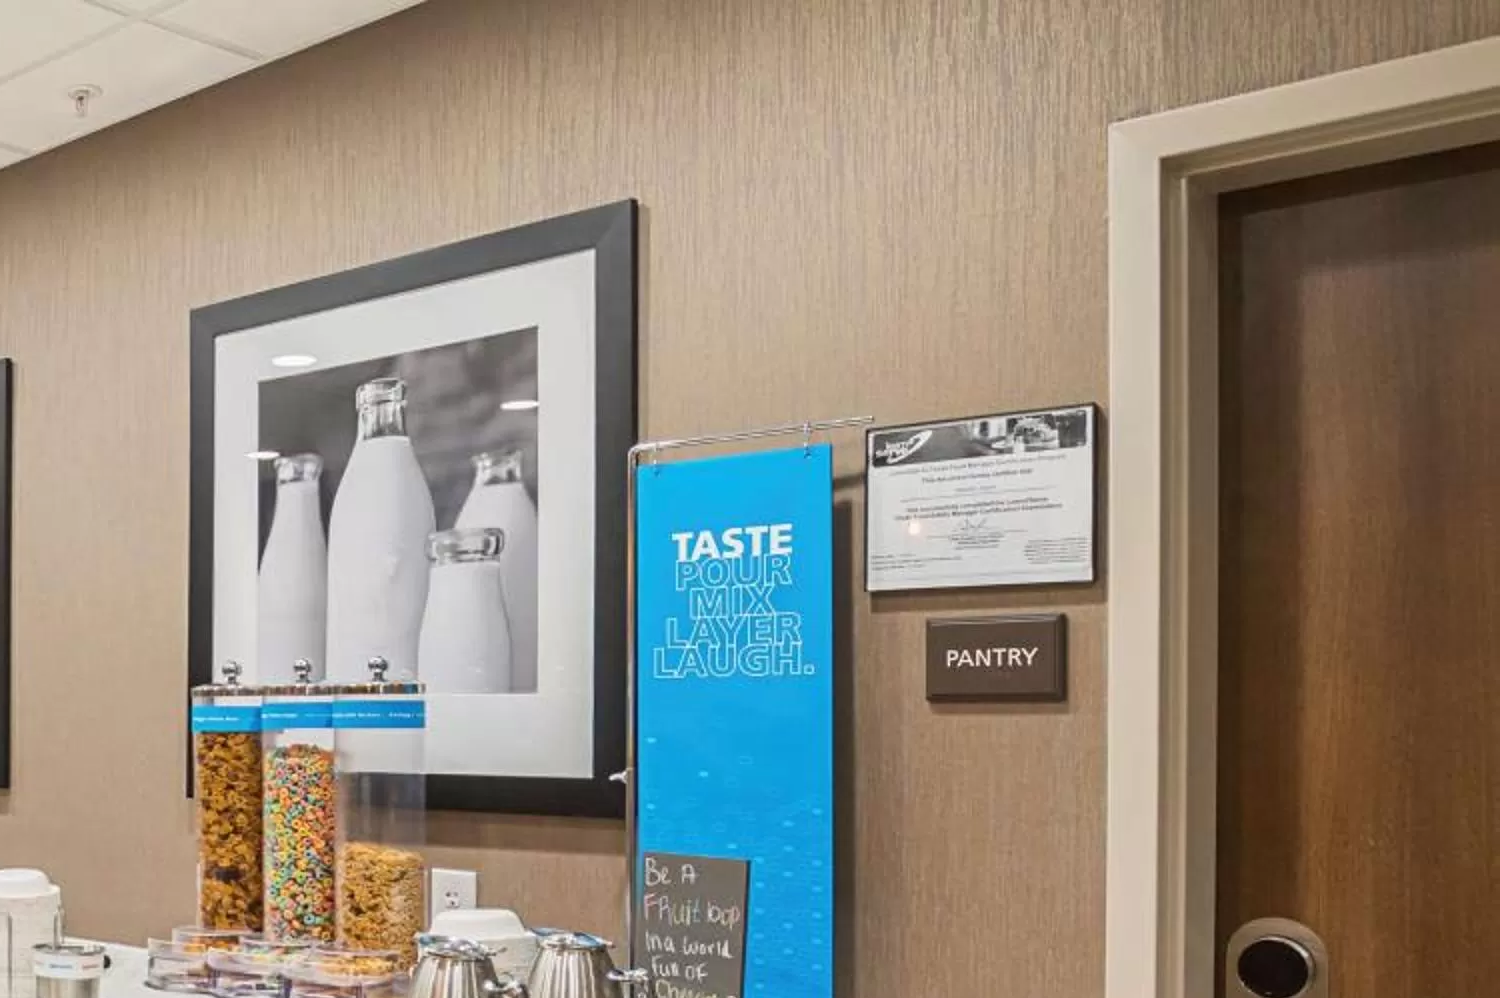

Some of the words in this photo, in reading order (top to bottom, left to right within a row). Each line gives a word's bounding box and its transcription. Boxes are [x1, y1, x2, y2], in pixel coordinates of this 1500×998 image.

[671, 523, 793, 562] TASTE
[675, 553, 793, 592] POUR
[689, 584, 776, 620] MIX
[666, 612, 803, 649] LAYER
[653, 643, 816, 679] LAUGH.
[945, 647, 1038, 668] PANTRY
[645, 857, 672, 886] Be
[681, 863, 696, 885] A
